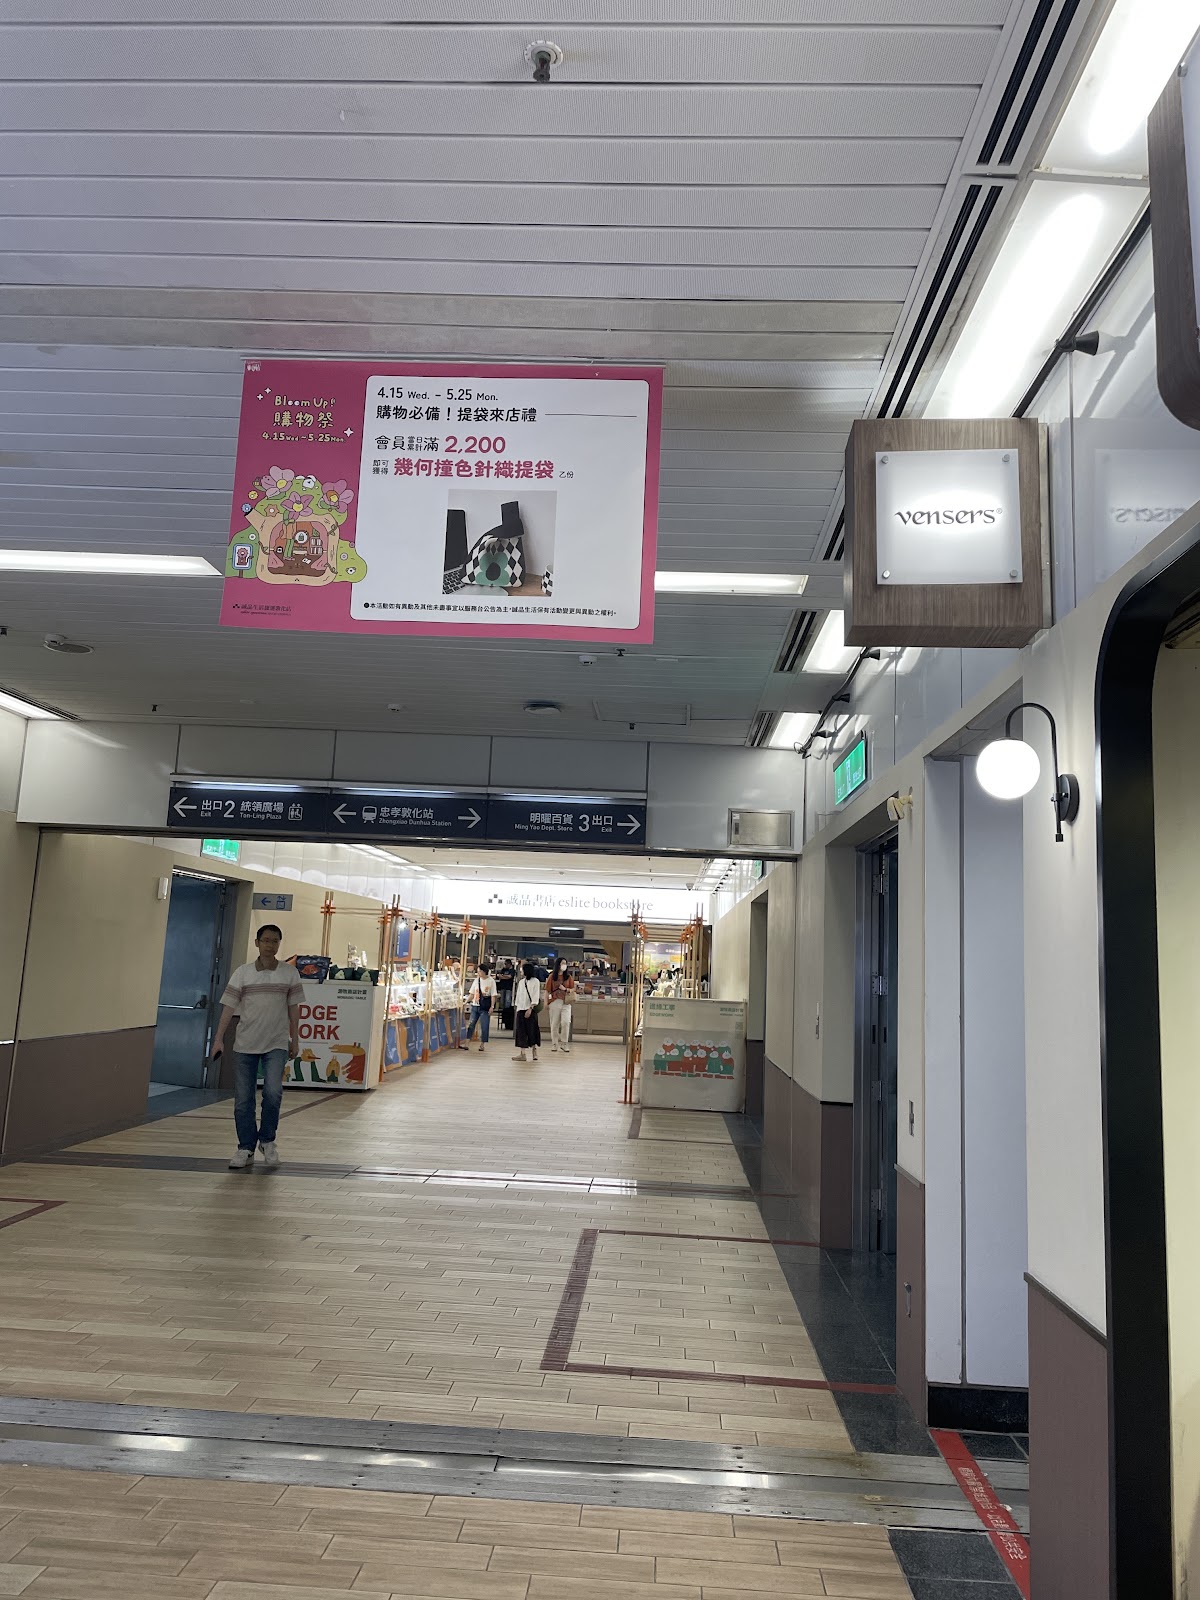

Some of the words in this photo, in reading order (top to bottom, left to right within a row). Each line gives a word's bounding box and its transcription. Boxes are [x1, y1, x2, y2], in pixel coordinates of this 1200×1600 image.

[275, 395, 310, 406] Bloom
[378, 387, 403, 399] 4.15
[408, 391, 430, 400] Wed.
[446, 389, 472, 400] 5.25
[477, 393, 498, 401] Mon.
[273, 410, 334, 428] 購物祭
[444, 436, 506, 454] 2,200
[394, 458, 554, 479] 幾何撞色針織提袋
[201, 800, 222, 811] 出口
[224, 800, 236, 818] 2
[240, 801, 284, 814] 統領廣場
[380, 807, 434, 820] 忠孝敦化站
[515, 823, 528, 831] Ming
[541, 824, 556, 832] Dept.
[530, 813, 574, 825] 明曜百貨
[578, 814, 590, 832] 3
[592, 815, 613, 826] 出口
[558, 896, 590, 908] eslite
[593, 897, 653, 910] bookstore
[298, 1004, 338, 1020] DGE
[298, 1024, 340, 1040] ORK
